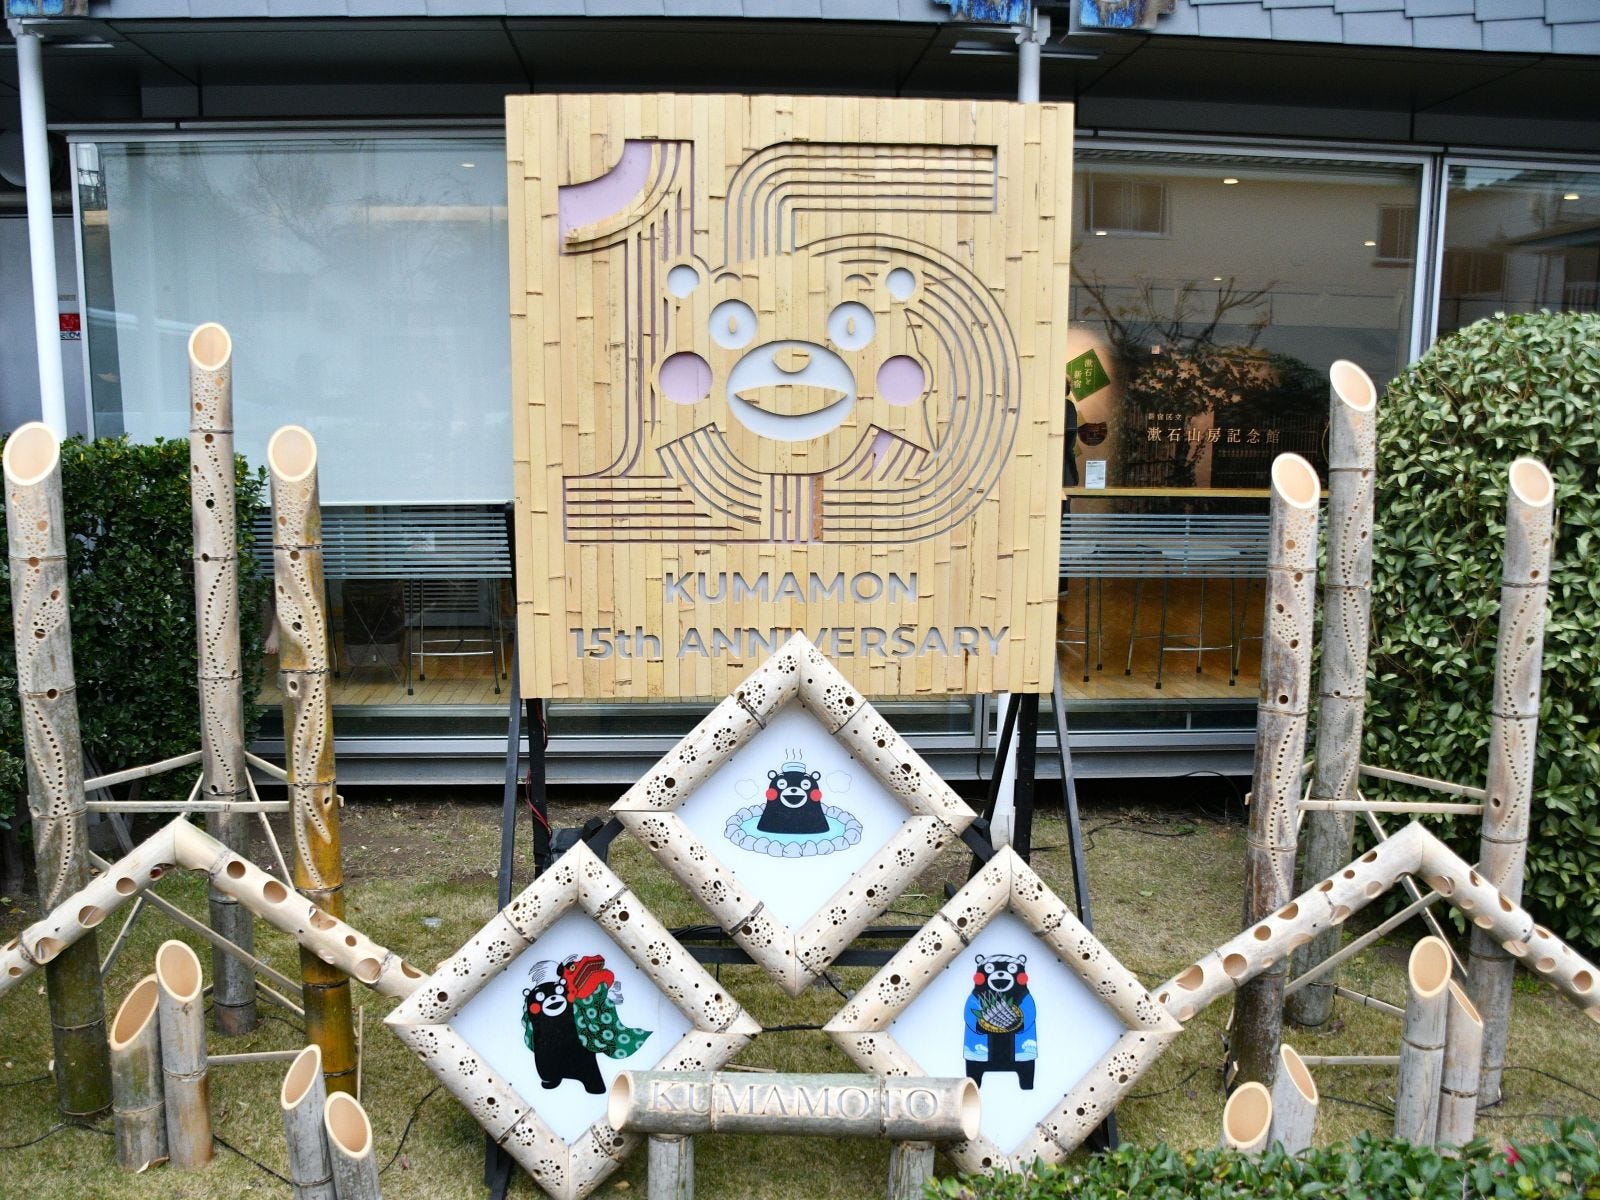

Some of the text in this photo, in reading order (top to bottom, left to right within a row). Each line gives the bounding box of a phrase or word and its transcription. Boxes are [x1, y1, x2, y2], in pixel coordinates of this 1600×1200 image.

[1147, 426, 1280, 444] 漱石山房記念館
[664, 571, 919, 604] KUMAMON
[569, 626, 663, 660] 15th
[648, 1082, 939, 1120] KUMAMOTO
